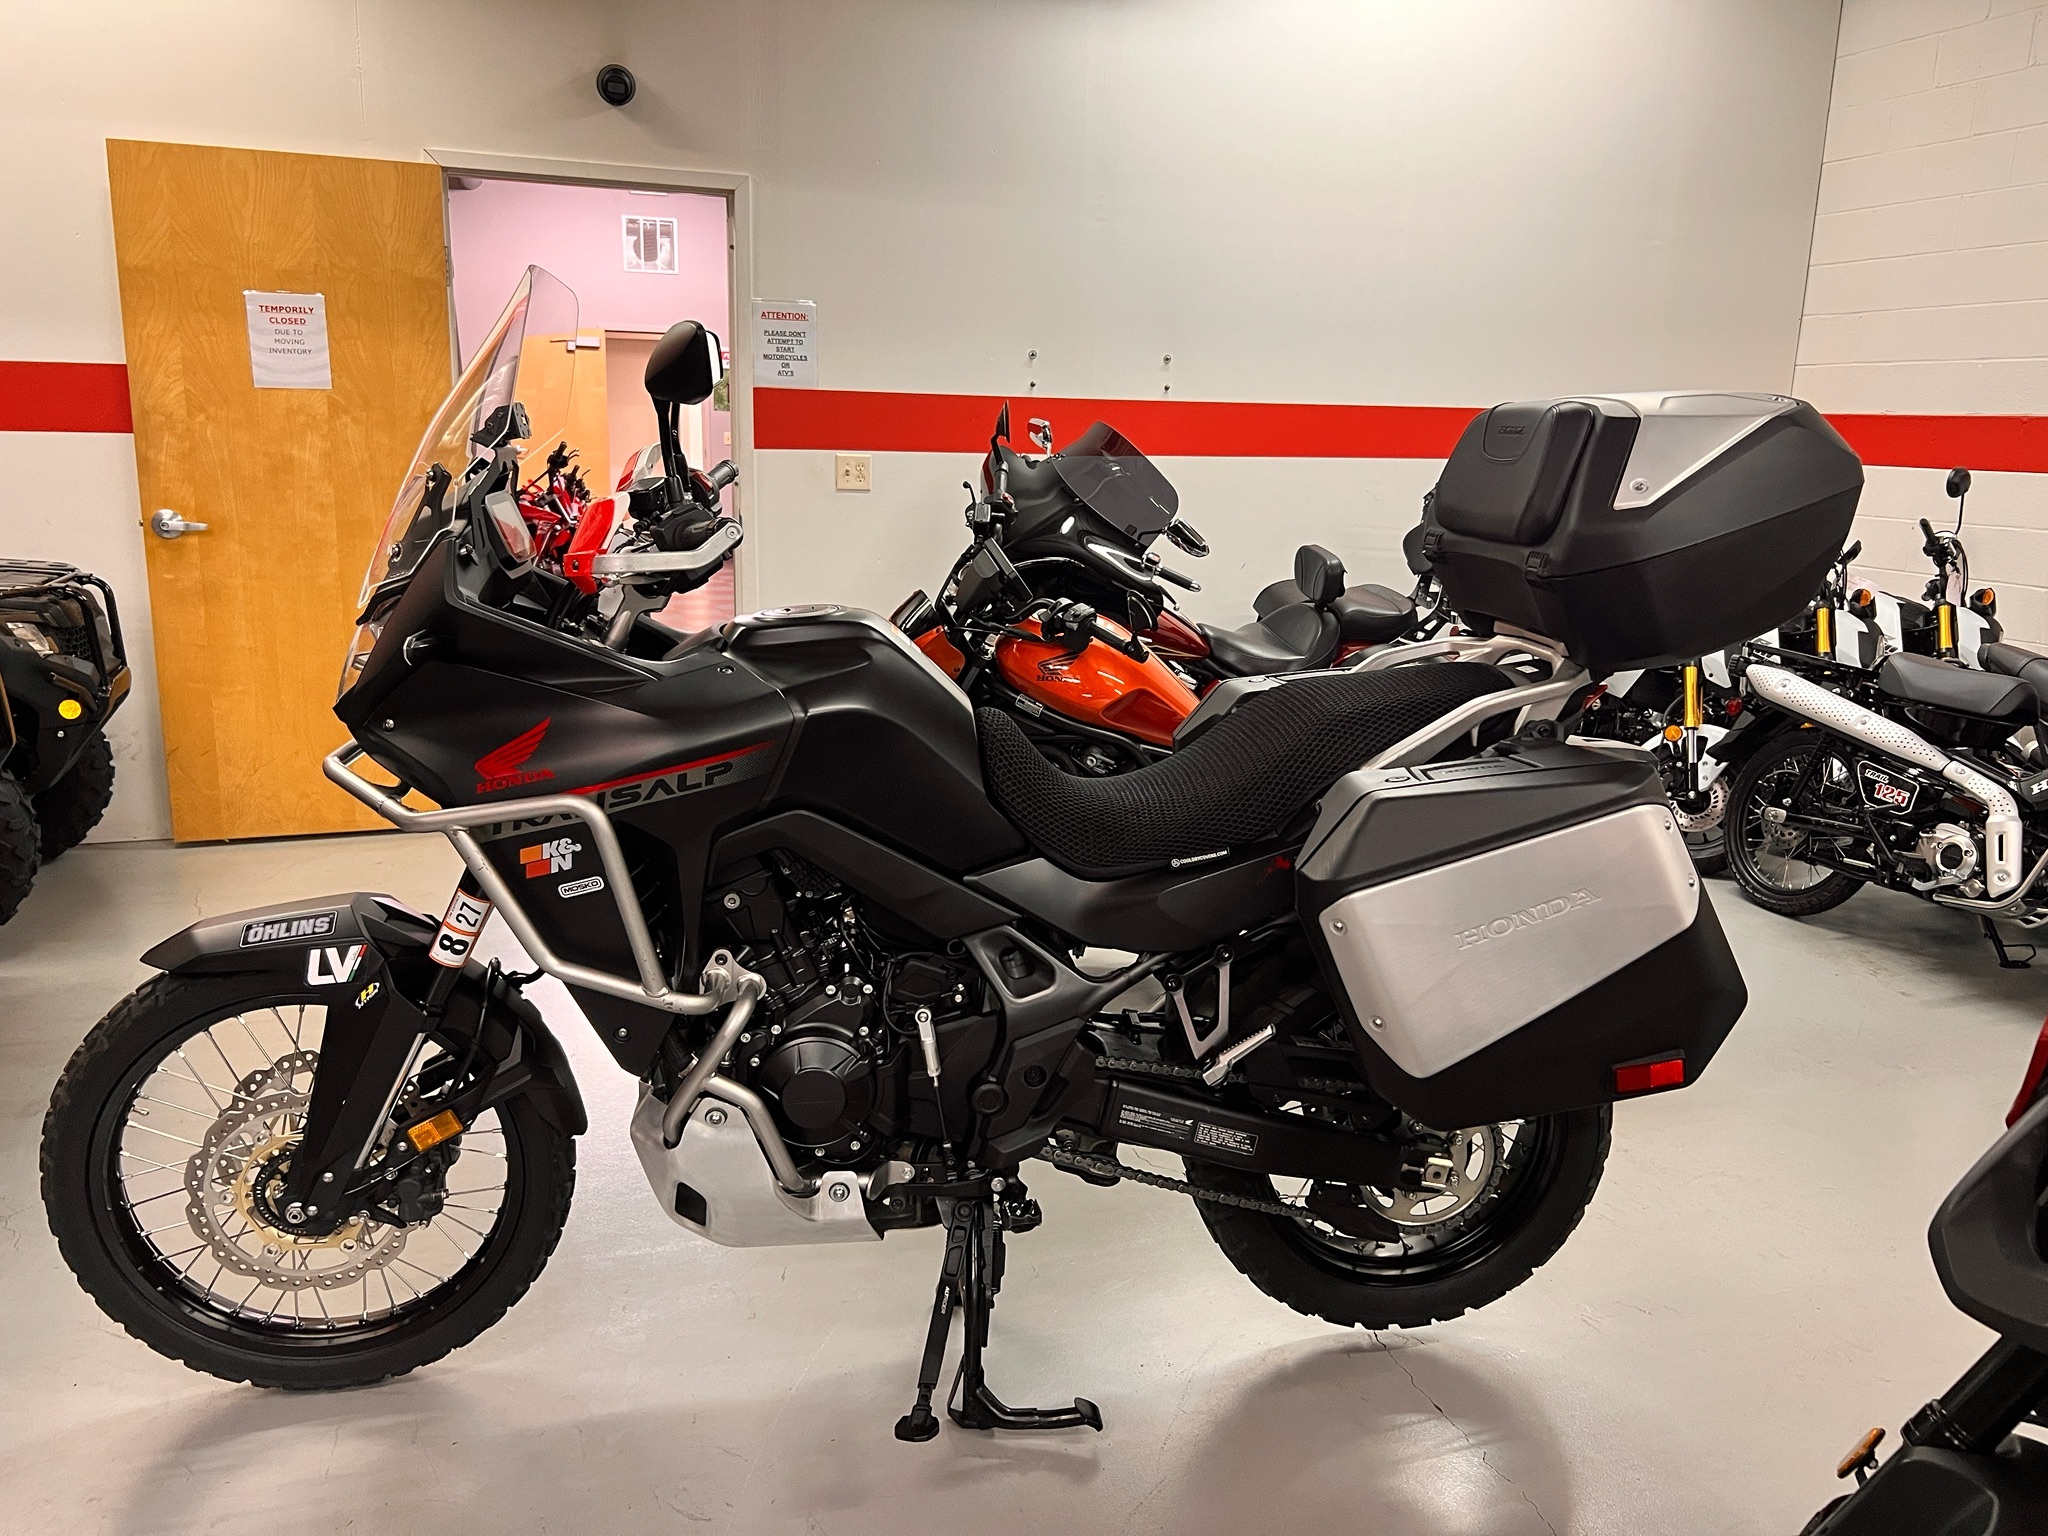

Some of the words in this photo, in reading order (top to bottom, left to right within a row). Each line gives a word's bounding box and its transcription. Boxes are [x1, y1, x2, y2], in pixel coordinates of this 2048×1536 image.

[259, 305, 314, 314] TEMPORILY
[269, 317, 306, 325] CLOSED
[761, 311, 809, 321] ATTENTION:
[476, 768, 554, 794] HONDA
[1865, 769, 1889, 783] TRAIL
[1874, 783, 1910, 807] 125
[563, 880, 599, 894] MOSKO
[247, 916, 331, 943] ÖHLINS
[439, 933, 470, 956] 8
[455, 901, 482, 928] 27
[1454, 887, 1602, 951] HONDA
[307, 944, 363, 986] LV
